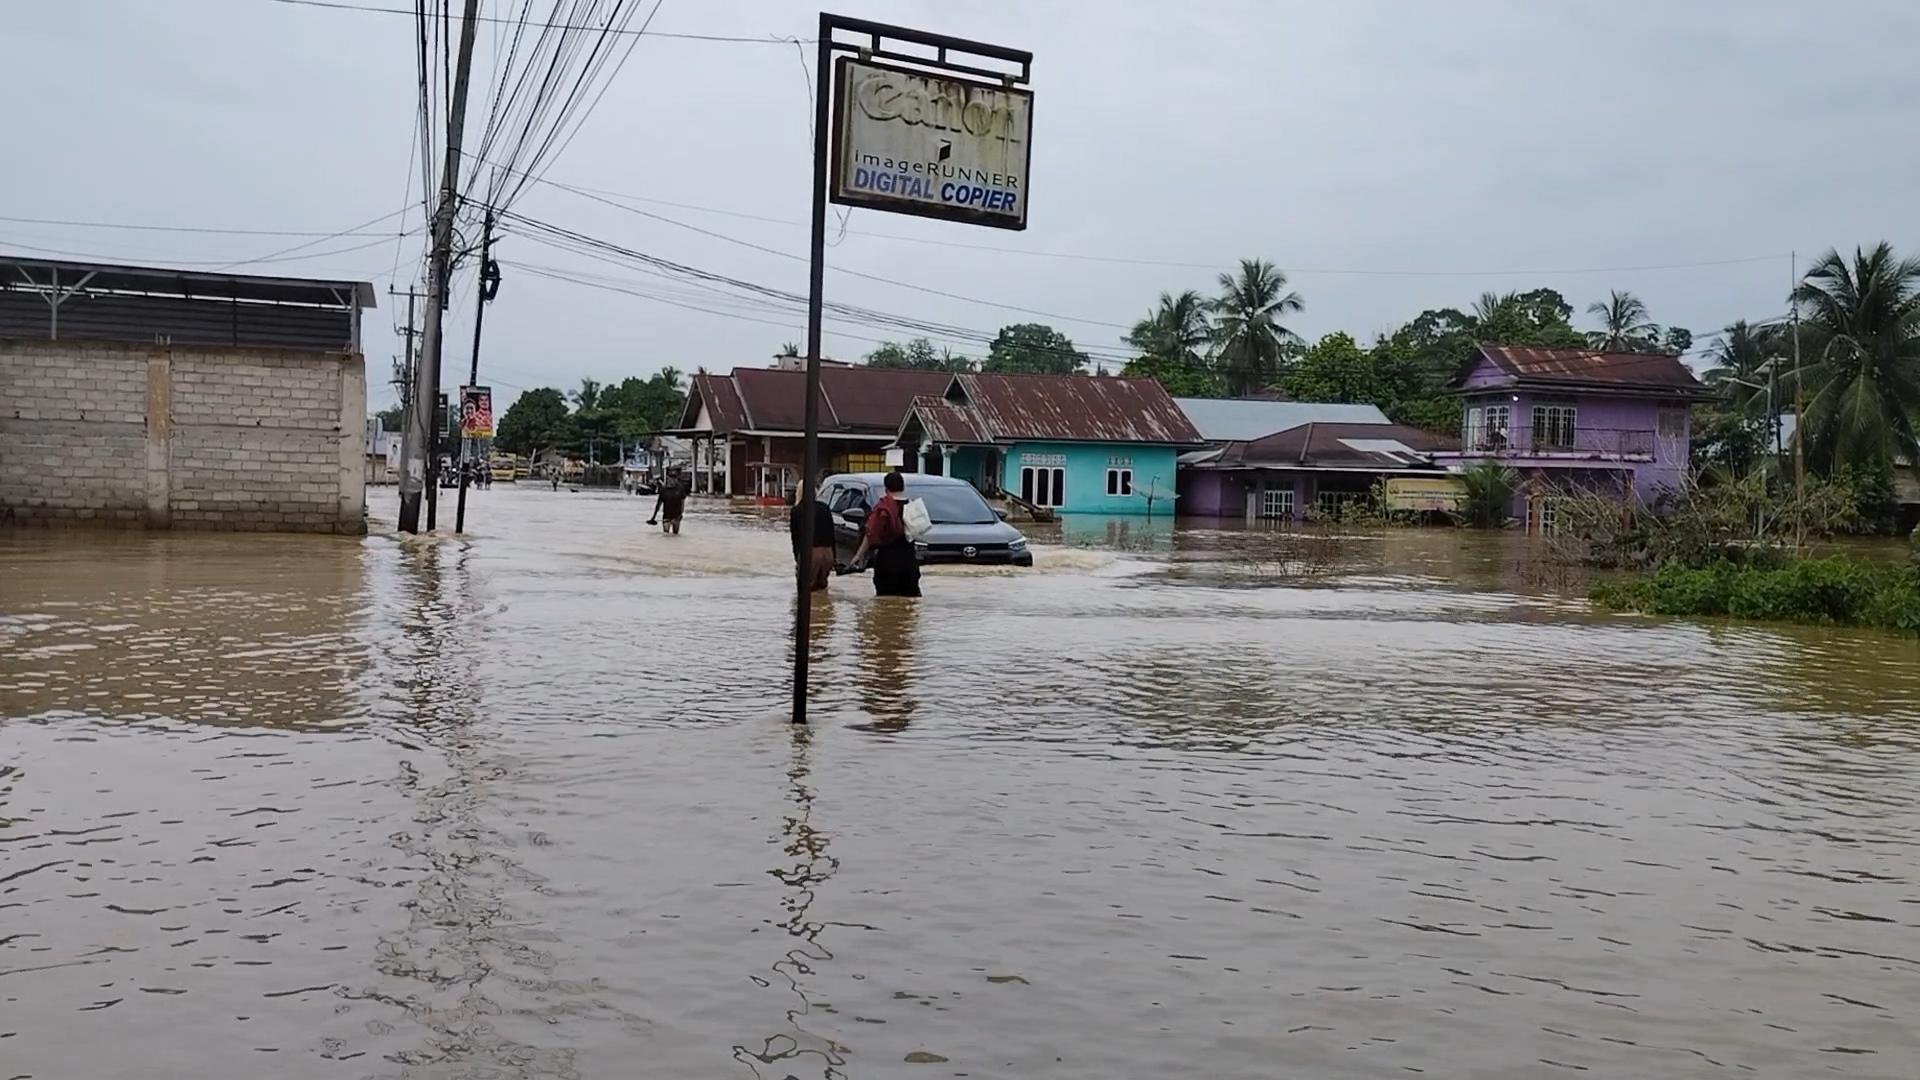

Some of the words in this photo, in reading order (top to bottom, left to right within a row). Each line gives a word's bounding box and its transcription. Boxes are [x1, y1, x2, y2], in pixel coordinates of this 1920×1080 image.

[858, 75, 1021, 143] Canon
[854, 167, 934, 200] DIGITAL
[941, 182, 1017, 212] COPIER
[855, 150, 1018, 188] imageRUNNER
